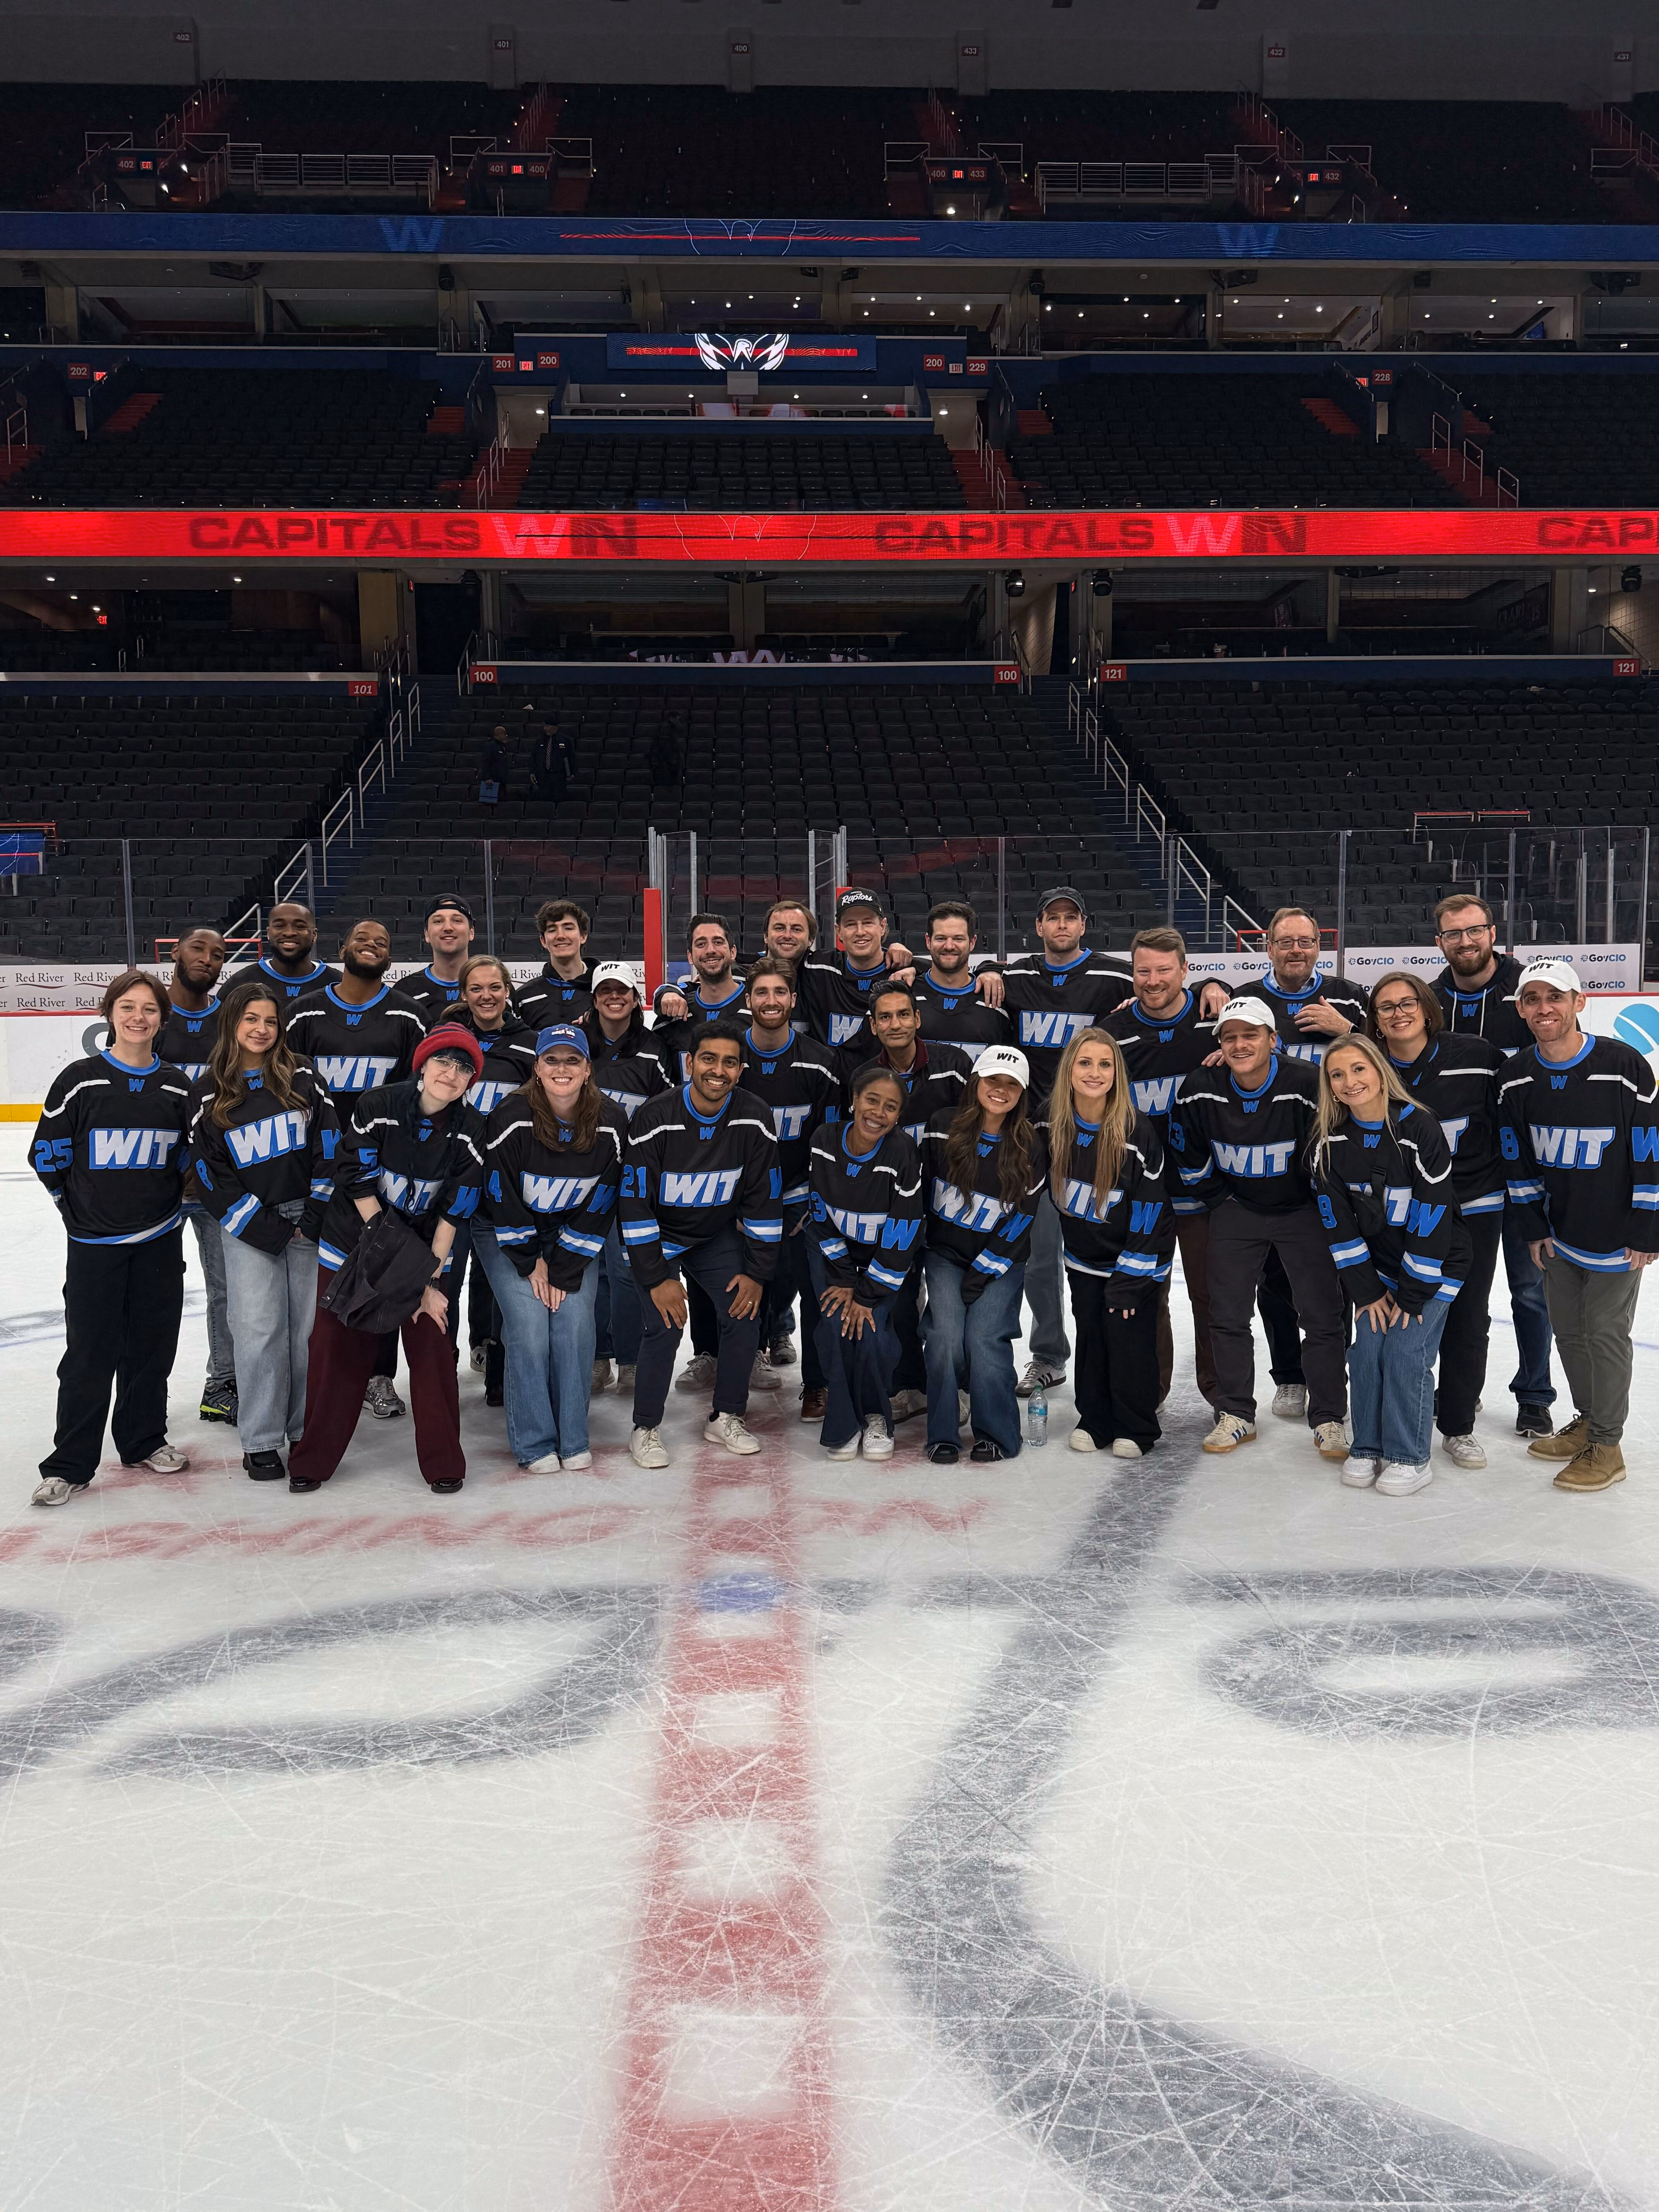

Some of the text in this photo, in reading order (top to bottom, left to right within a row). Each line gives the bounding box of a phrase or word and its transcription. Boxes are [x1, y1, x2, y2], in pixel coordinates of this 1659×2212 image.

[964, 46, 977, 55] 433
[530, 165, 545, 173] 400
[496, 360, 511, 368] 201
[540, 356, 557, 364] 200
[926, 359, 943, 367] 200
[70, 367, 87, 375] 202
[969, 363, 986, 371] 229
[1375, 373, 1391, 381] 228
[190, 517, 480, 551] CAPITALS
[875, 519, 1155, 552] CAPITALS
[1537, 517, 1659, 547] CAP
[1105, 669, 1122, 679] 121
[1618, 663, 1635, 673] 121
[474, 671, 494, 682] 100
[998, 670, 1017, 680] 100
[354, 685, 372, 694] 101
[1357, 957, 1395, 965] GovCIO
[1589, 954, 1626, 962] GovCIO
[601, 963, 620, 972] WIT
[1188, 963, 1226, 971] GovCIO
[1242, 962, 1273, 970] GovCI
[1528, 962, 1554, 973] WIT
[15, 973, 35, 982] Red
[38, 973, 64, 982] River
[74, 972, 117, 982] Red Riv
[520, 969, 541, 979] Rive
[1053, 974, 1068, 987] W
[286, 986, 301, 996] W
[858, 979, 872, 991] W
[446, 990, 460, 1001] W
[562, 989, 575, 1000] W
[17, 998, 36, 1007] Red
[40, 998, 65, 1007] River
[75, 997, 94, 1006] Red
[943, 998, 958, 1010] W
[1224, 1001, 1247, 1012] WIT
[706, 1011, 720, 1021] W
[1462, 1003, 1478, 1017] W
[347, 1013, 362, 1025] W
[187, 1020, 202, 1033] W
[1019, 1010, 1097, 1048] WIT
[1159, 1029, 1174, 1043] W
[478, 1041, 493, 1052] W
[996, 1053, 1020, 1063] WIT
[314, 1055, 398, 1092] WIT
[762, 1062, 777, 1074] W
[129, 1079, 145, 1092] W
[1551, 1075, 1568, 1090] W
[1242, 1100, 1259, 1114] W
[771, 1104, 812, 1141] IT
[224, 1107, 313, 1170] WIT
[700, 1127, 716, 1140] W
[1077, 1132, 1094, 1148] W
[1364, 1134, 1381, 1149] W
[1500, 1126, 1519, 1161] 8
[1528, 1123, 1616, 1169] WIT
[35, 1138, 73, 1172] 25
[89, 1128, 181, 1170] WIT
[976, 1142, 993, 1158] W
[1211, 1139, 1297, 1178] WIT
[846, 1162, 862, 1178] W
[621, 1164, 646, 1198] 21
[659, 1165, 744, 1207] WIT
[378, 1164, 445, 1216] WIT
[520, 1171, 601, 1214] WIT
[447, 1186, 481, 1218] W
[587, 1183, 616, 1214] W
[930, 1176, 1015, 1233] WIT
[1130, 1200, 1163, 1235] W
[1317, 1194, 1338, 1229] 9
[1407, 1198, 1447, 1237] W
[998, 1212, 1034, 1242] W
[881, 1217, 921, 1251] W
